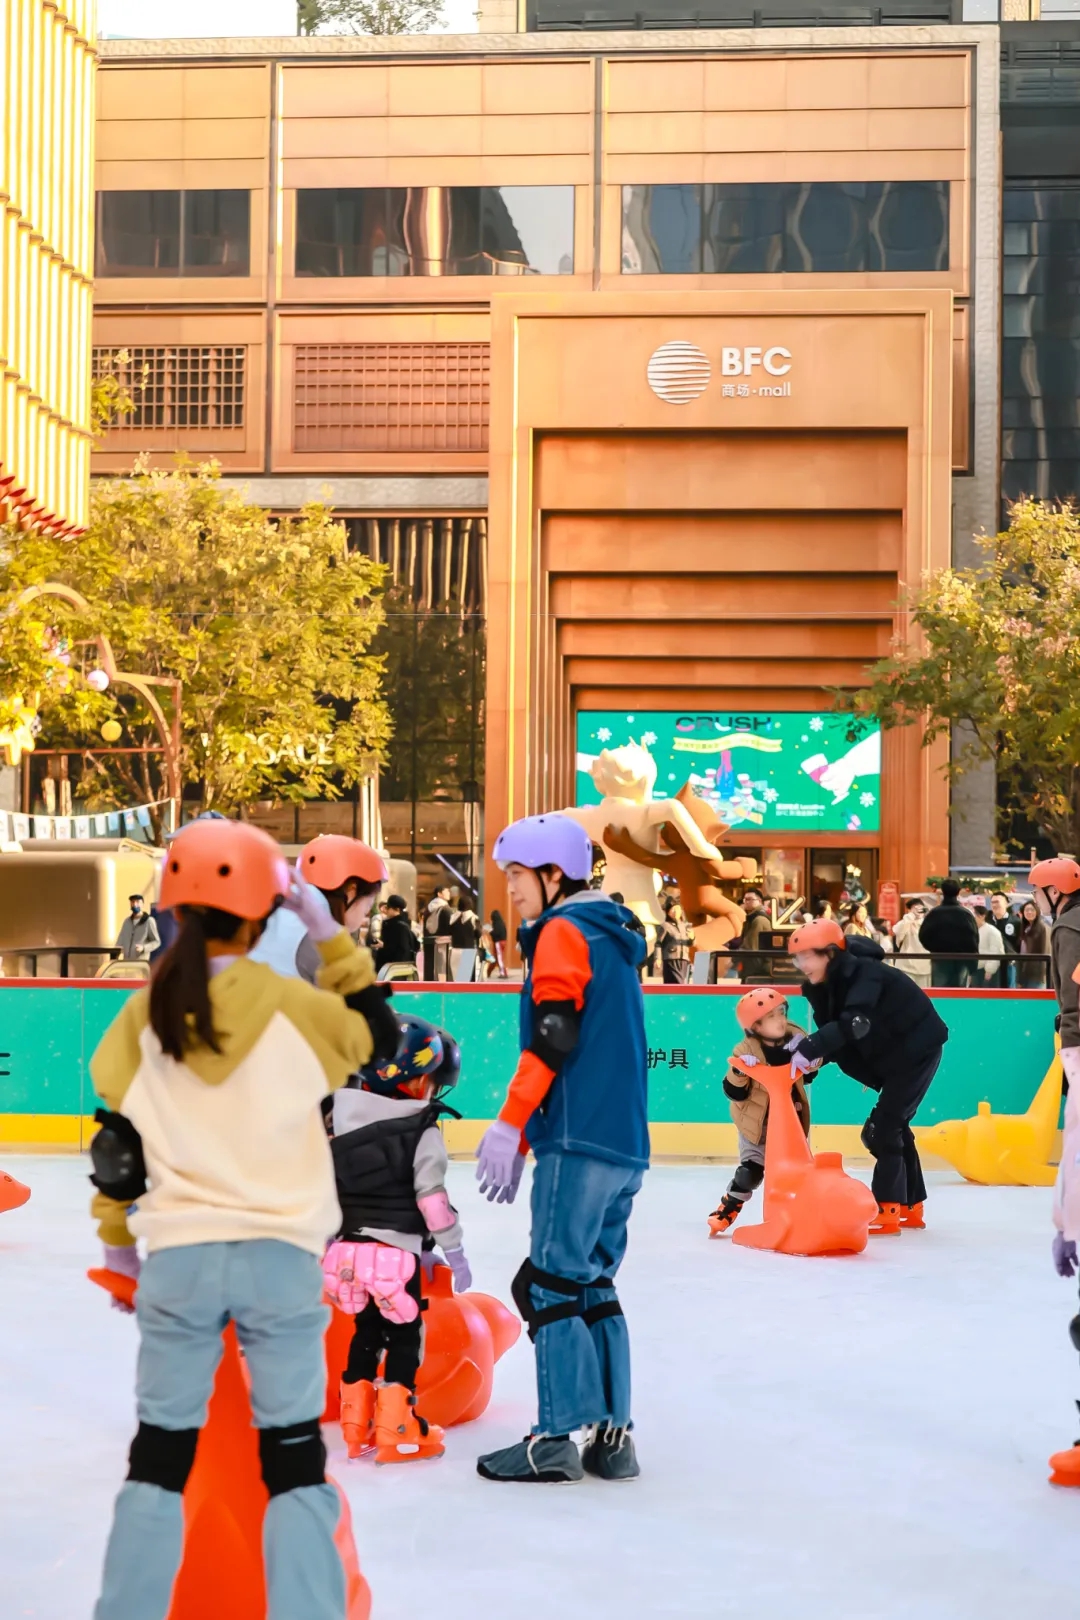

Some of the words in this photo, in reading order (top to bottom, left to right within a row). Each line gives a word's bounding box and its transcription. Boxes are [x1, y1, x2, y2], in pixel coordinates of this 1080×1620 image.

[721, 346, 792, 376] BFC
[675, 716, 772, 732] CRUSH
[647, 1048, 689, 1069] 护具
